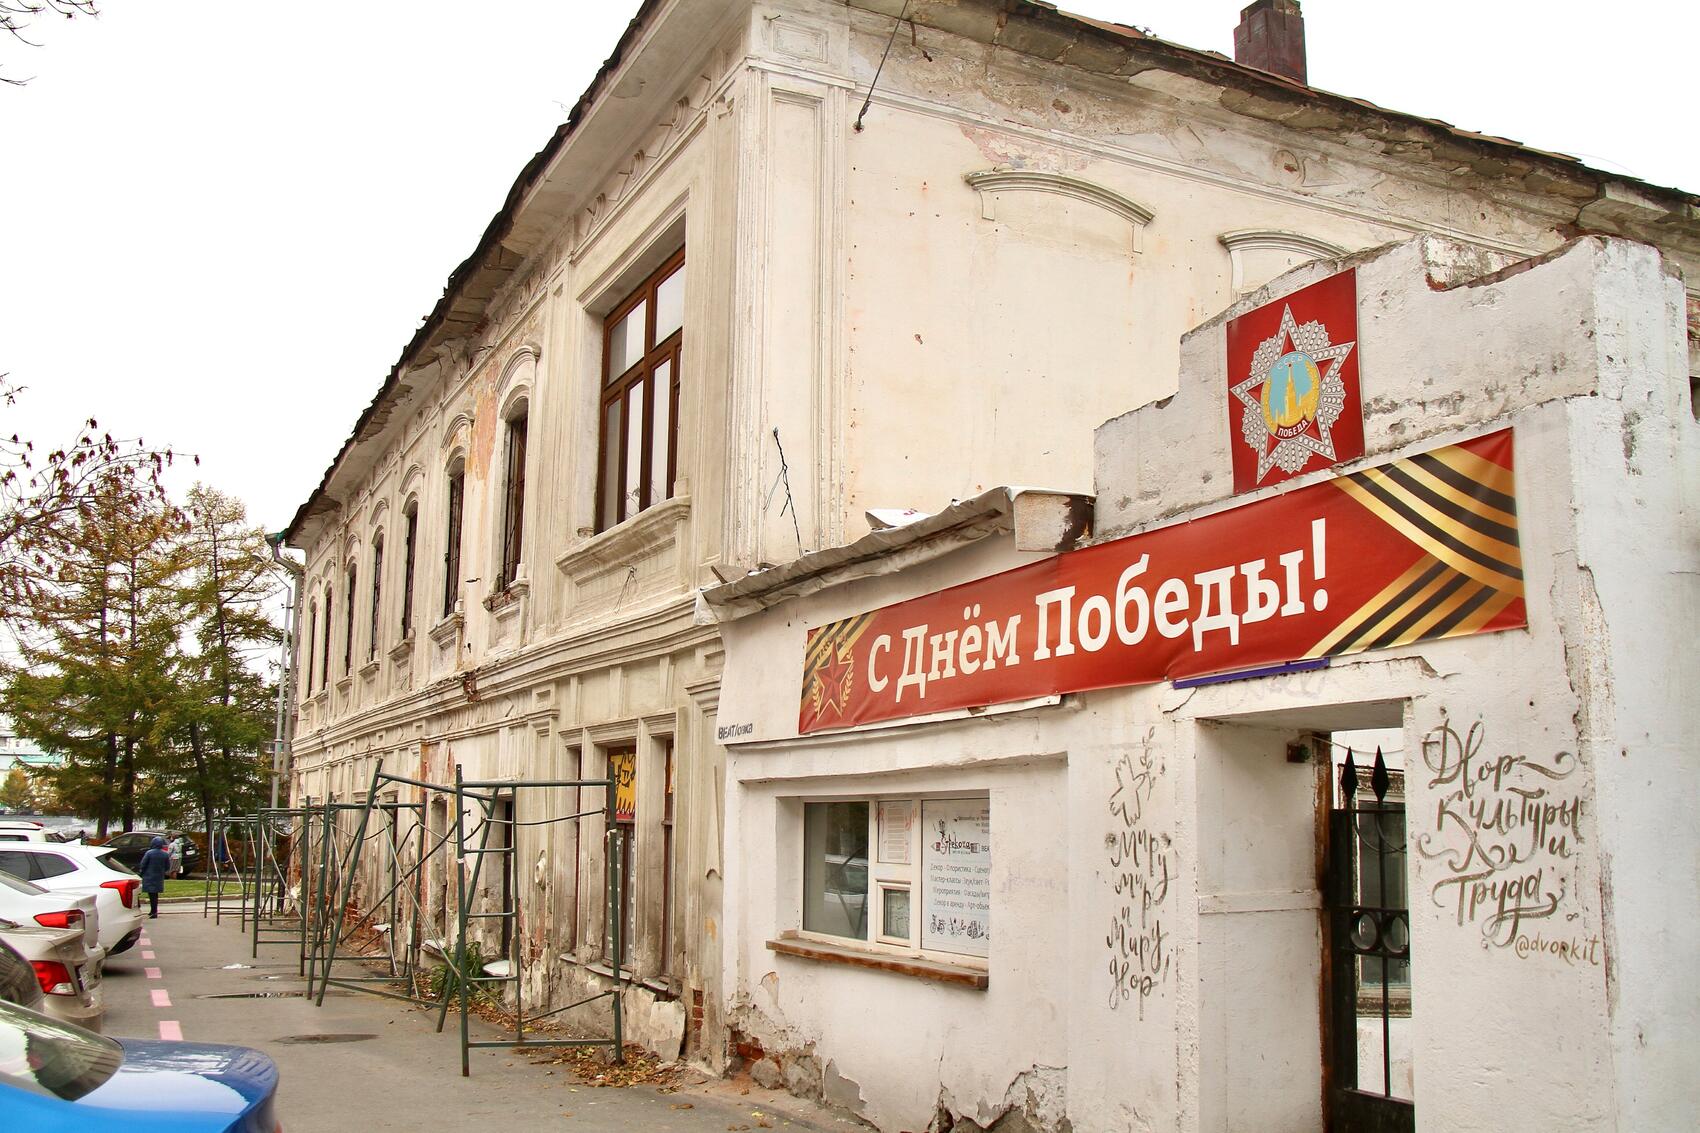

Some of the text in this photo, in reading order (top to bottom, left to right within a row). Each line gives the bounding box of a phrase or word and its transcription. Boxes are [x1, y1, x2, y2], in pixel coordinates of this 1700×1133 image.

[1277, 419, 1308, 437] ПОБЕДА
[896, 603, 1022, 703] Днём
[1034, 517, 1328, 652] Победы!
[1422, 717, 1575, 798] Двор
[1437, 787, 1584, 864] Культуры
[1549, 835, 1575, 860] и
[1433, 868, 1562, 947] Труда
